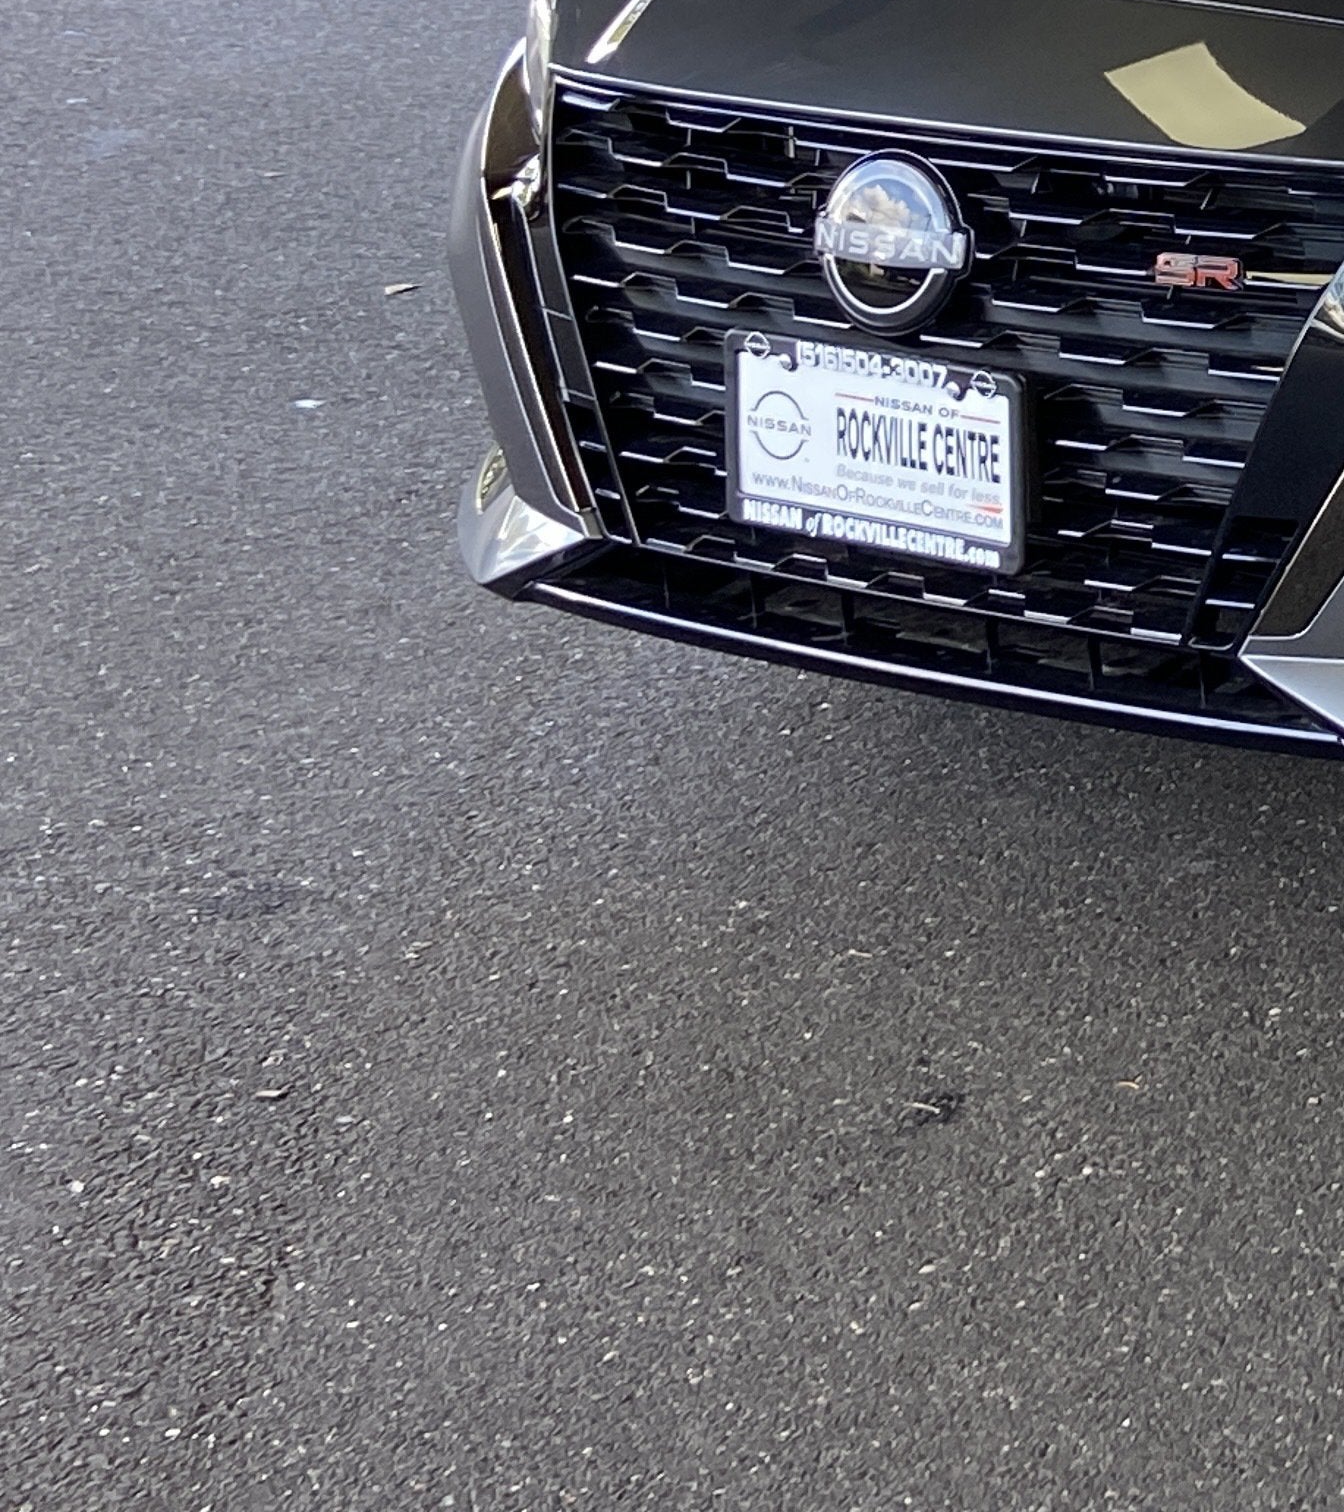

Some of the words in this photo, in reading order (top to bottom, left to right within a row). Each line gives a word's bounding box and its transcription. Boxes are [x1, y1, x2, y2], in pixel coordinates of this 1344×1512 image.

[816, 222, 962, 266] NISSAN
[1155, 252, 1243, 291] SR
[747, 414, 812, 437] NISSAN
[875, 396, 933, 415] NISSAN
[938, 406, 960, 420] OF
[837, 406, 929, 472] ROCKVILLE
[932, 423, 1001, 484] CENTRE
[836, 463, 894, 487] Because
[742, 498, 803, 531] NISSAN
[805, 512, 822, 538] of
